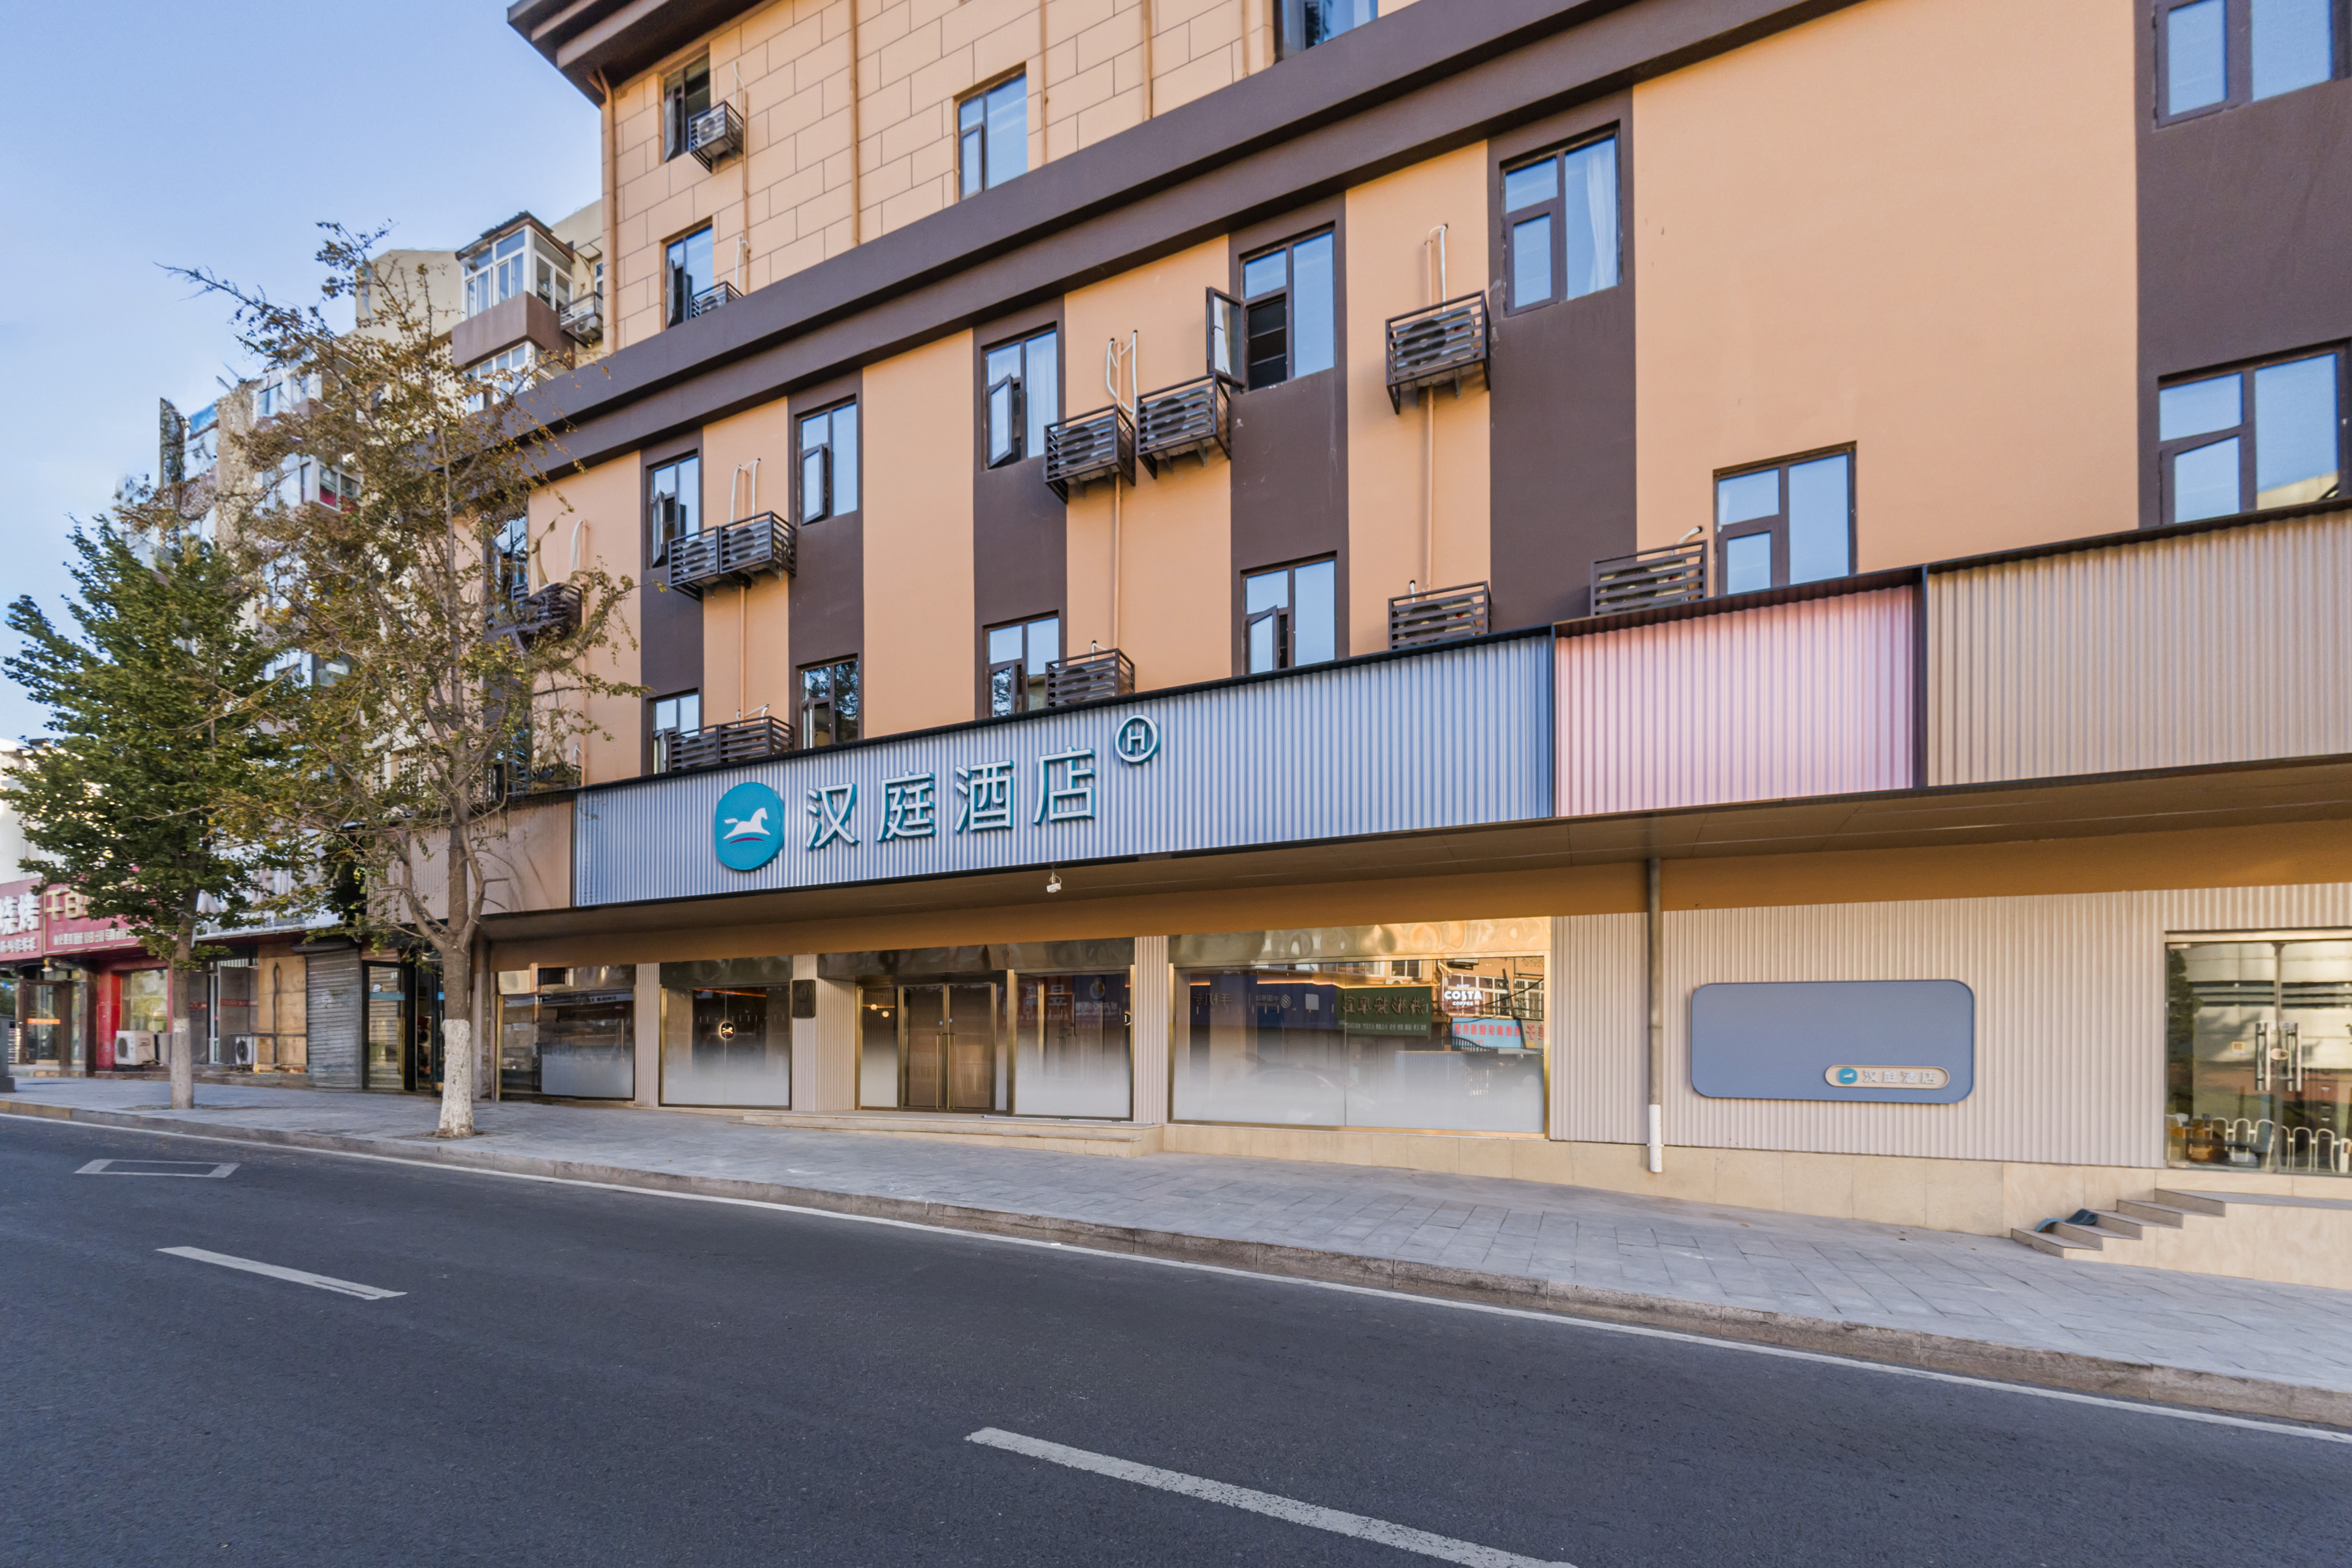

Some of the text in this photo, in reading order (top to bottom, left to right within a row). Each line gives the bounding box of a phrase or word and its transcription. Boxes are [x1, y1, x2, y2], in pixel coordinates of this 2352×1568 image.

[806, 746, 1096, 850] 汉庭酒店
[1444, 990, 1482, 1001] COSTA
[1863, 1070, 1936, 1085] 汉庭酒店
